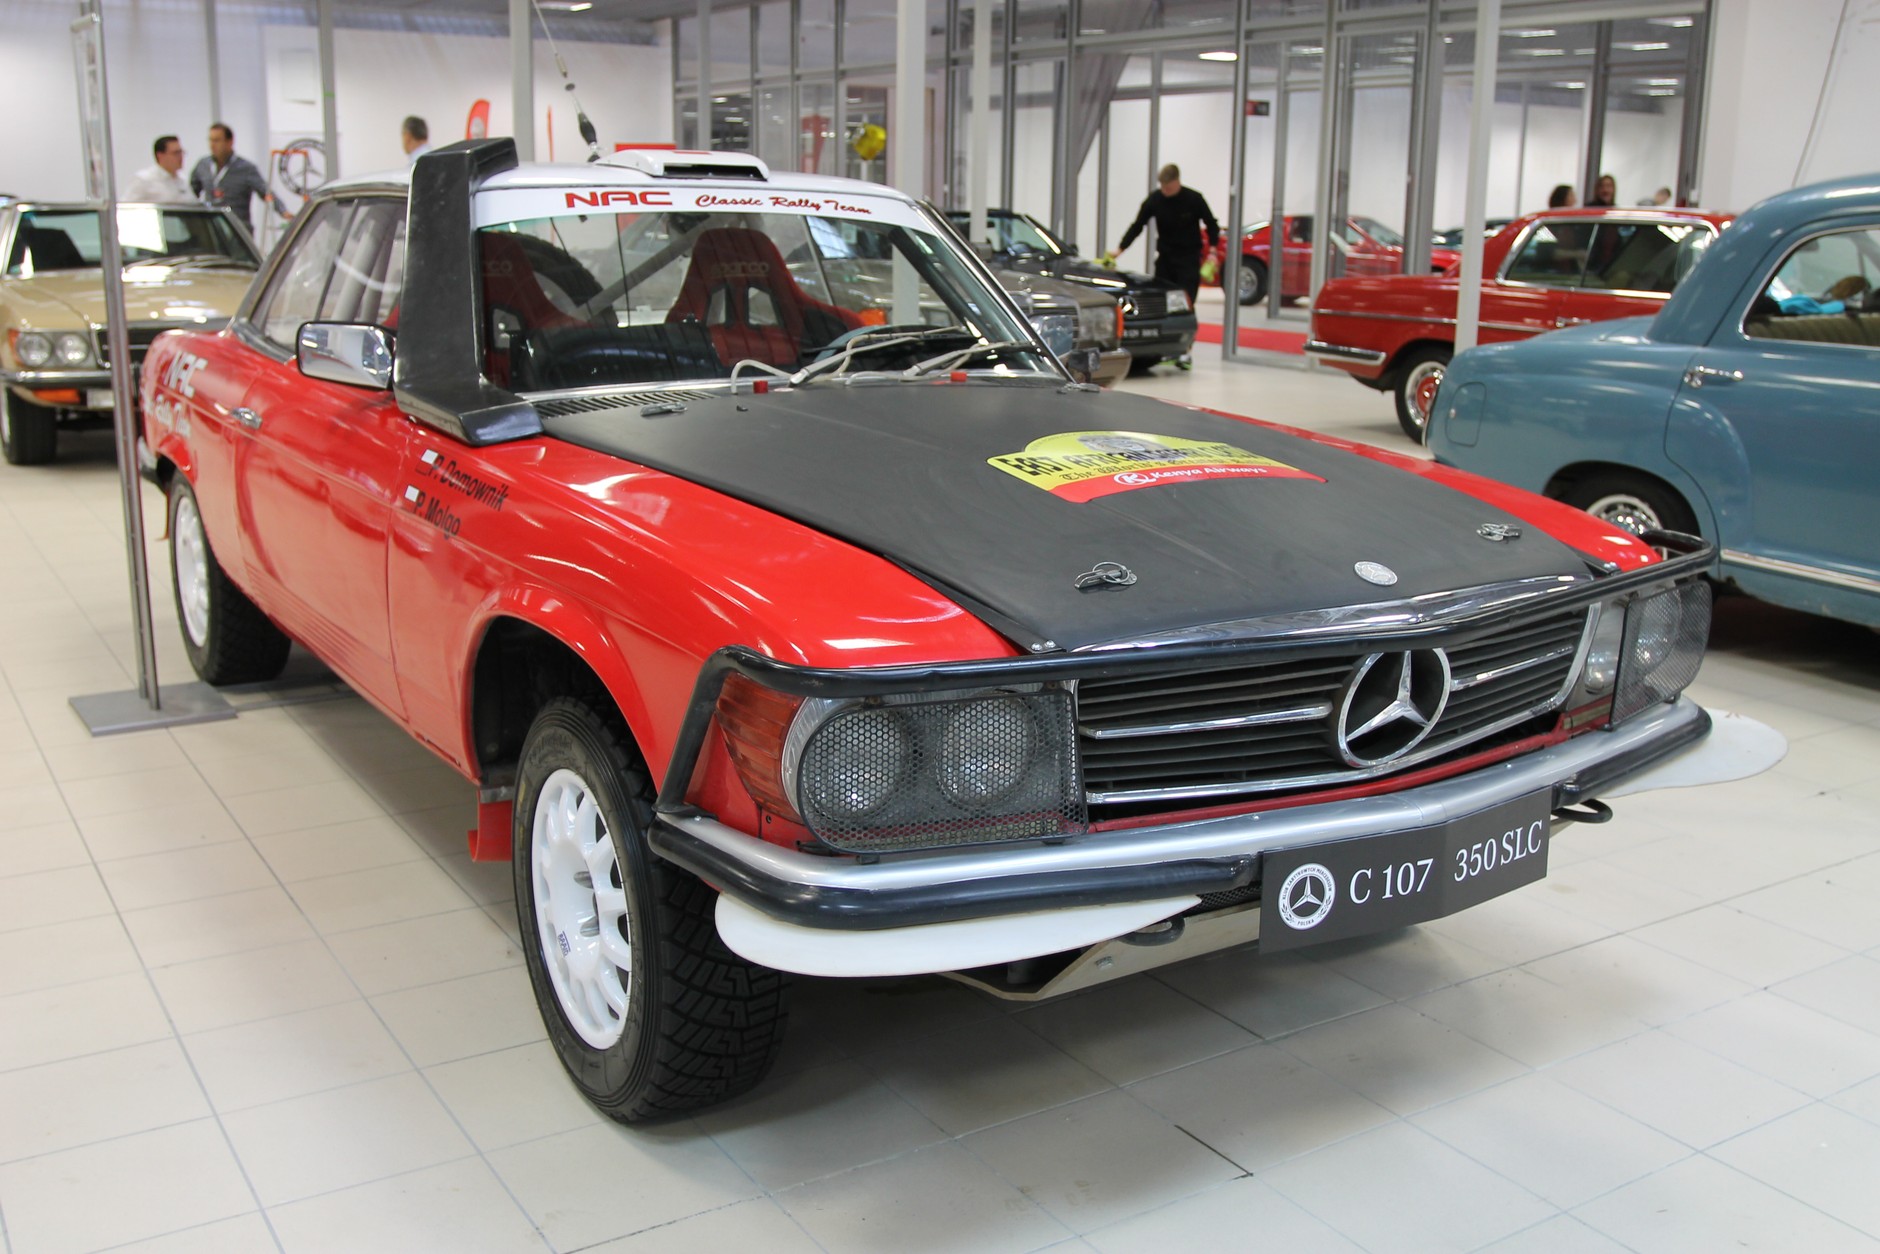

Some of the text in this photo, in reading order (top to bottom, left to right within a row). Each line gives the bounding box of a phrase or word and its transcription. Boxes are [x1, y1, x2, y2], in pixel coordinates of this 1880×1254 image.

[565, 191, 872, 214] NAC Classic Rally Team
[996, 456, 1072, 476] EAST
[1062, 450, 1156, 469] AFRICAN
[1150, 468, 1203, 479] Kenya
[440, 460, 509, 512] Domownik
[1349, 820, 1543, 904] C 107 350 SLC
